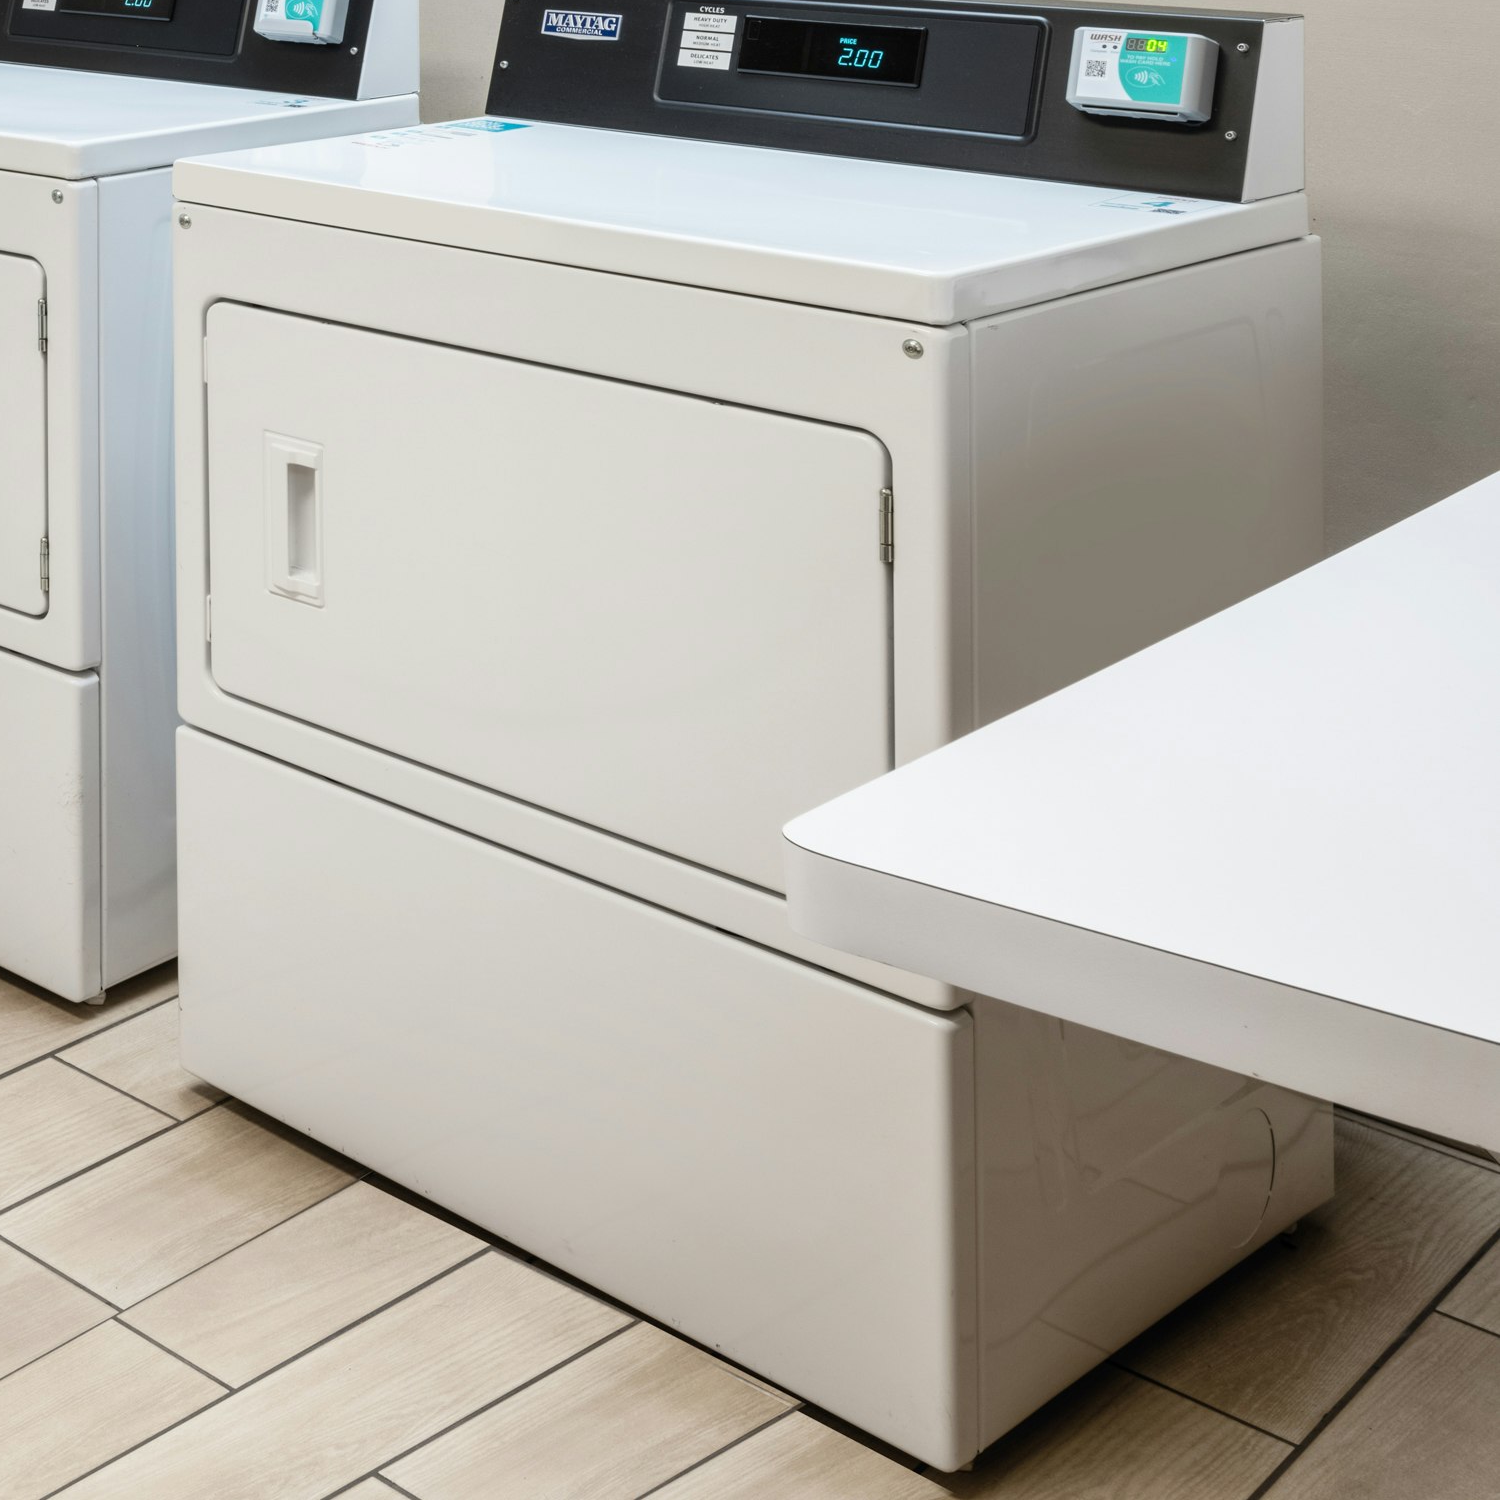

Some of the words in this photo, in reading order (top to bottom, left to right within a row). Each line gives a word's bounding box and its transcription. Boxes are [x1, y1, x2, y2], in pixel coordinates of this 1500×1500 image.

[699, 6, 725, 14] CYCLES
[546, 13, 617, 31] MAYTAG
[556, 27, 603, 36] COMMERCIAL
[1090, 33, 1122, 42] WASH
[1146, 39, 1168, 52] 04
[690, 53, 719, 61] DELICATES
[838, 48, 883, 68] 2.00
